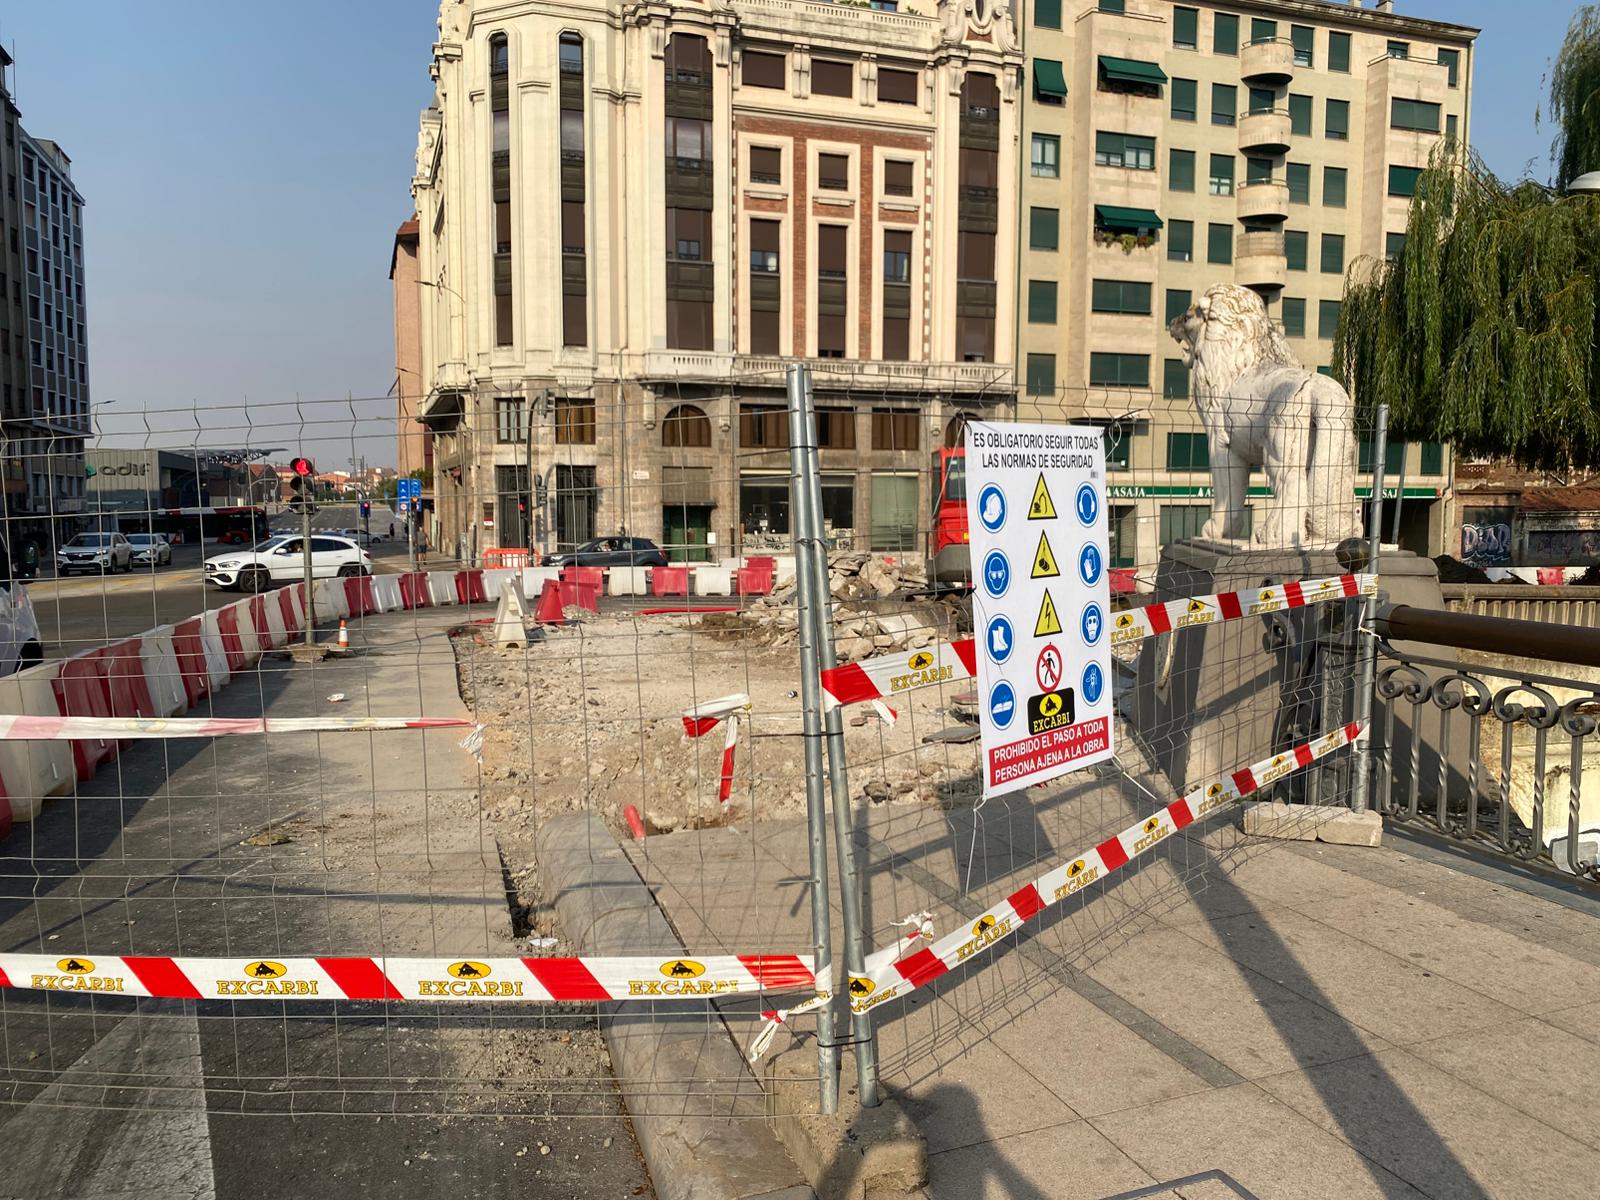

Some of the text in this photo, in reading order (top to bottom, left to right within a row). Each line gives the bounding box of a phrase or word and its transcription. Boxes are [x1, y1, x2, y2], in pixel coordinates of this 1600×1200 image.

[973, 432, 1099, 450] ES OBLIGATORIO SEGUIR TODAS
[982, 453, 1093, 468] LAS NORMAS DE SEGURIDAD
[1114, 487, 1146, 497] ASAJA
[890, 664, 953, 692] EXCARBI
[1033, 711, 1071, 733] EXCARBI
[994, 720, 1104, 763] PROHIBIDO EL PASO A TODA
[995, 738, 1105, 783] PERSONA AJENA A LA OBRA
[1133, 824, 1170, 854] EXCARBI
[1054, 866, 1099, 900] EXCARBI
[956, 918, 1012, 962] EXCARBI
[31, 975, 124, 992] EXCARBI
[216, 980, 319, 995] EXCARBI
[418, 980, 524, 996] EXCARBI
